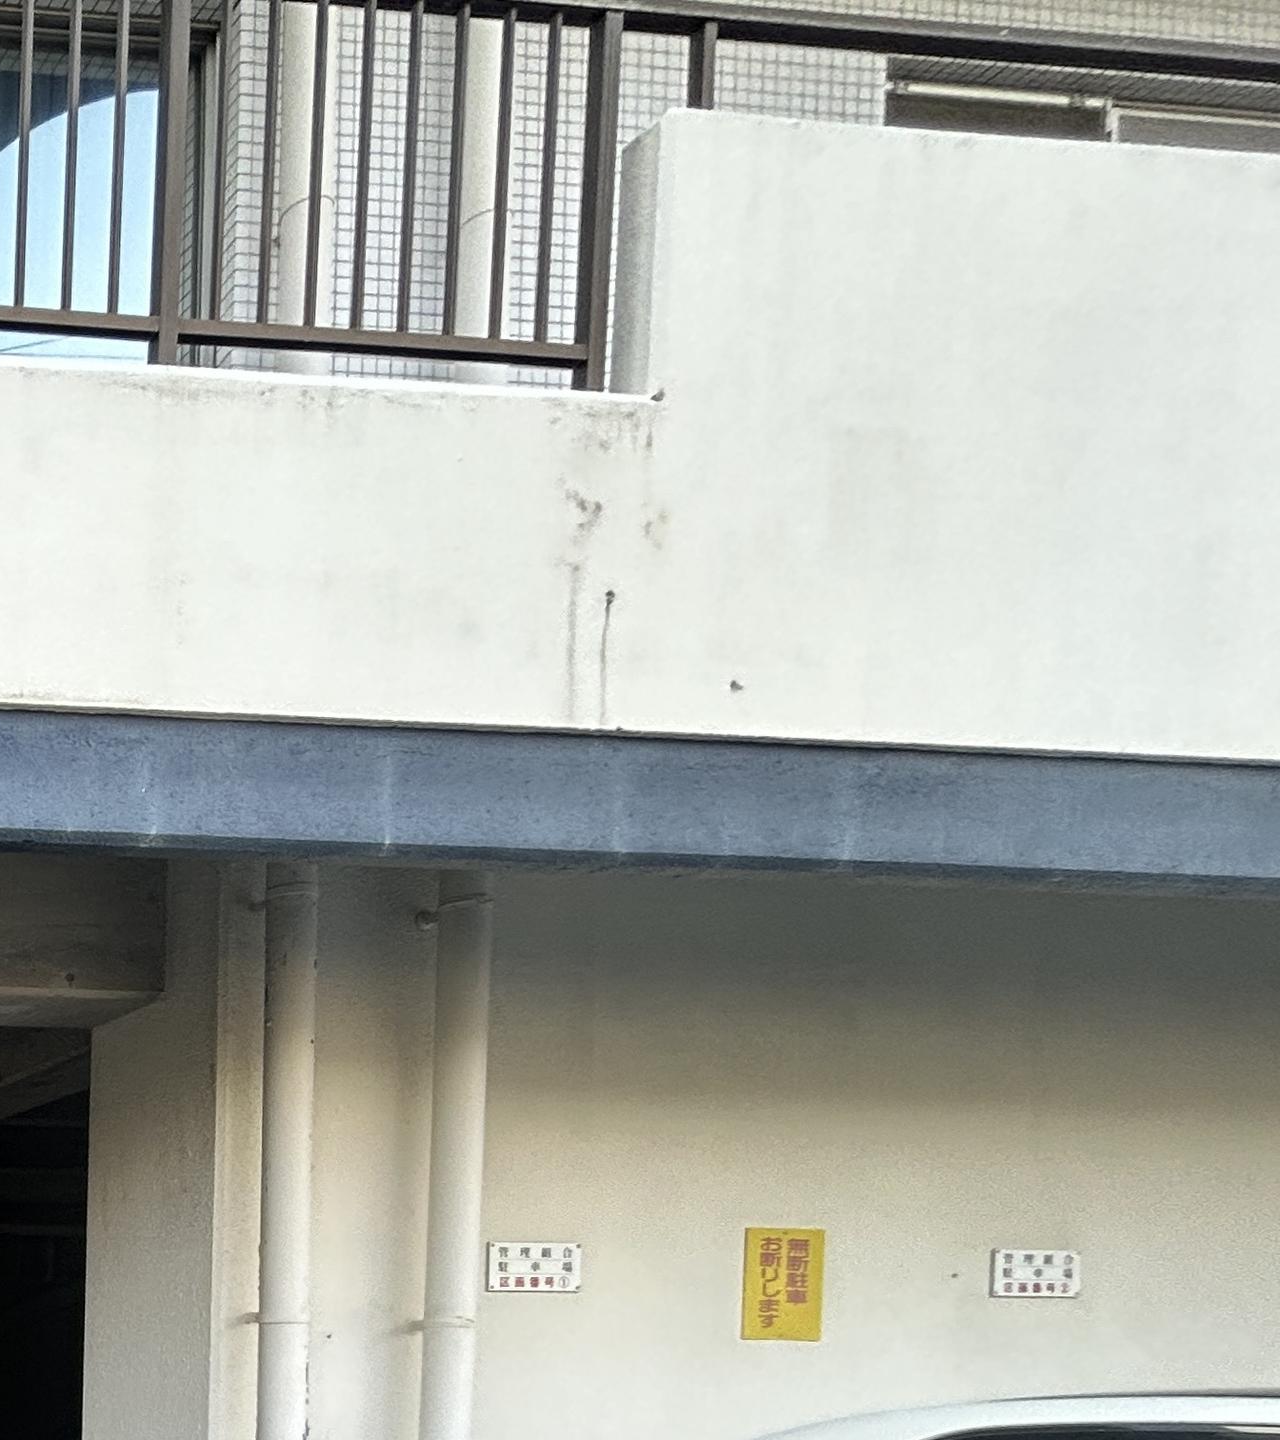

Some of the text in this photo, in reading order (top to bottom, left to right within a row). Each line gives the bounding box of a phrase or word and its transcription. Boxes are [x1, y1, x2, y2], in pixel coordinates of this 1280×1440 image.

[498, 1247, 573, 1258] 管理組合
[498, 1262, 572, 1272] 駐車場
[786, 1237, 810, 1306] 無断駐車
[758, 1236, 783, 1328] お断りします
